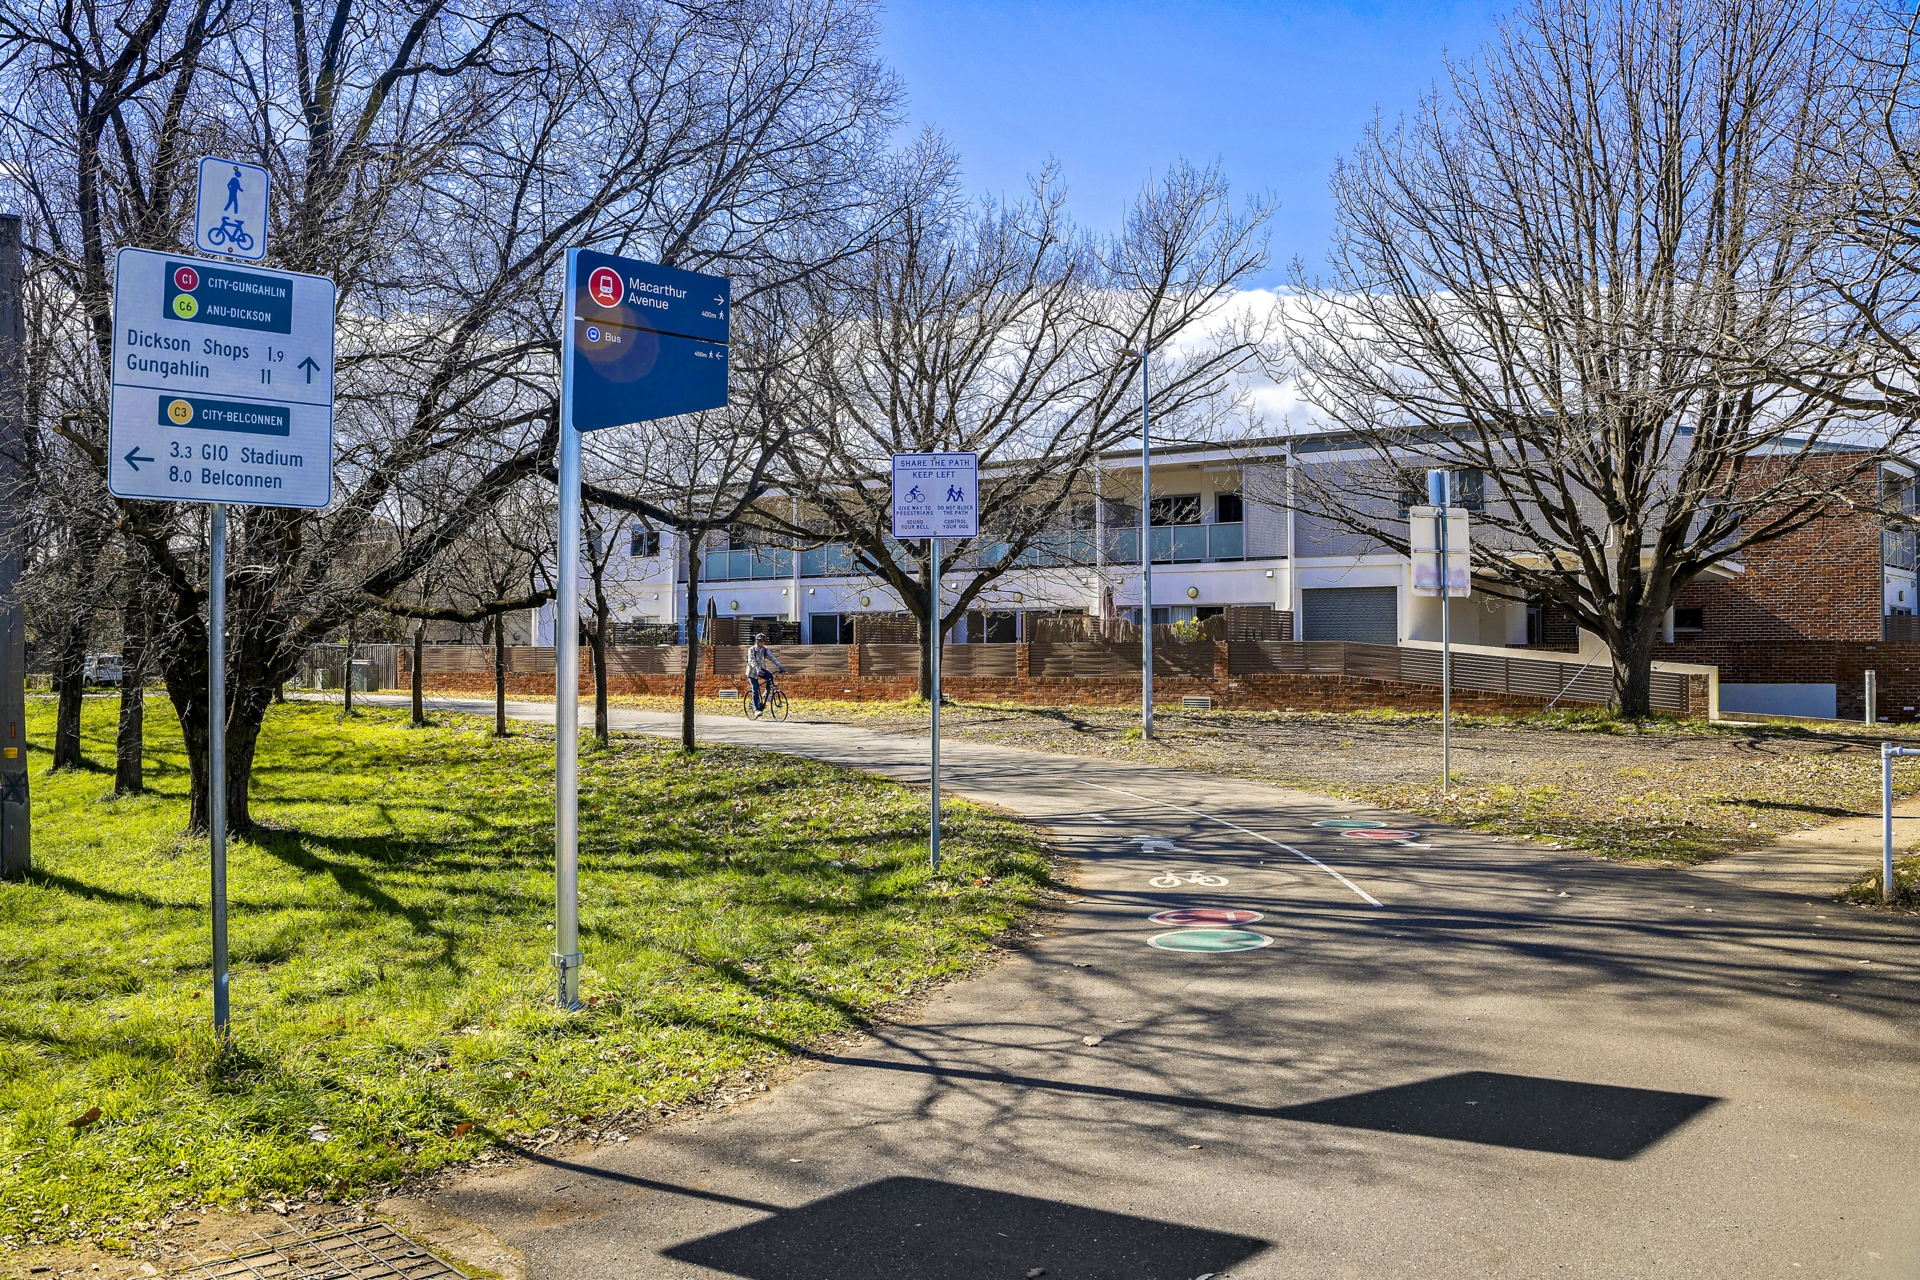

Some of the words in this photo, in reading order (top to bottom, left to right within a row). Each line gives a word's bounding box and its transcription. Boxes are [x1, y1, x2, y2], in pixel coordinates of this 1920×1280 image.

[181, 273, 192, 285] C1
[208, 277, 286, 298] CITY-GUNGAHLIN
[629, 277, 687, 299] Macarthur
[628, 291, 669, 310] Avenue
[179, 301, 192, 312] C6
[206, 304, 271, 323] ANU-DICKSON
[701, 310, 717, 319] 400m
[127, 329, 191, 352] Dickson
[203, 338, 250, 361] Shops
[267, 346, 284, 363] 1.9
[605, 332, 621, 343] Bus
[127, 353, 209, 378] Gungahlin
[260, 368, 271, 385] 11
[174, 406, 187, 418] C3
[202, 409, 283, 427] CITY-BELCONNEN
[170, 441, 192, 459] 3.3
[201, 443, 229, 462] GIO
[240, 447, 303, 467] Stadium
[930, 459, 946, 467] THE
[948, 459, 970, 467] PATH
[169, 465, 192, 483] 8.0
[201, 467, 282, 489] Belconnen
[912, 471, 934, 479] KEEP
